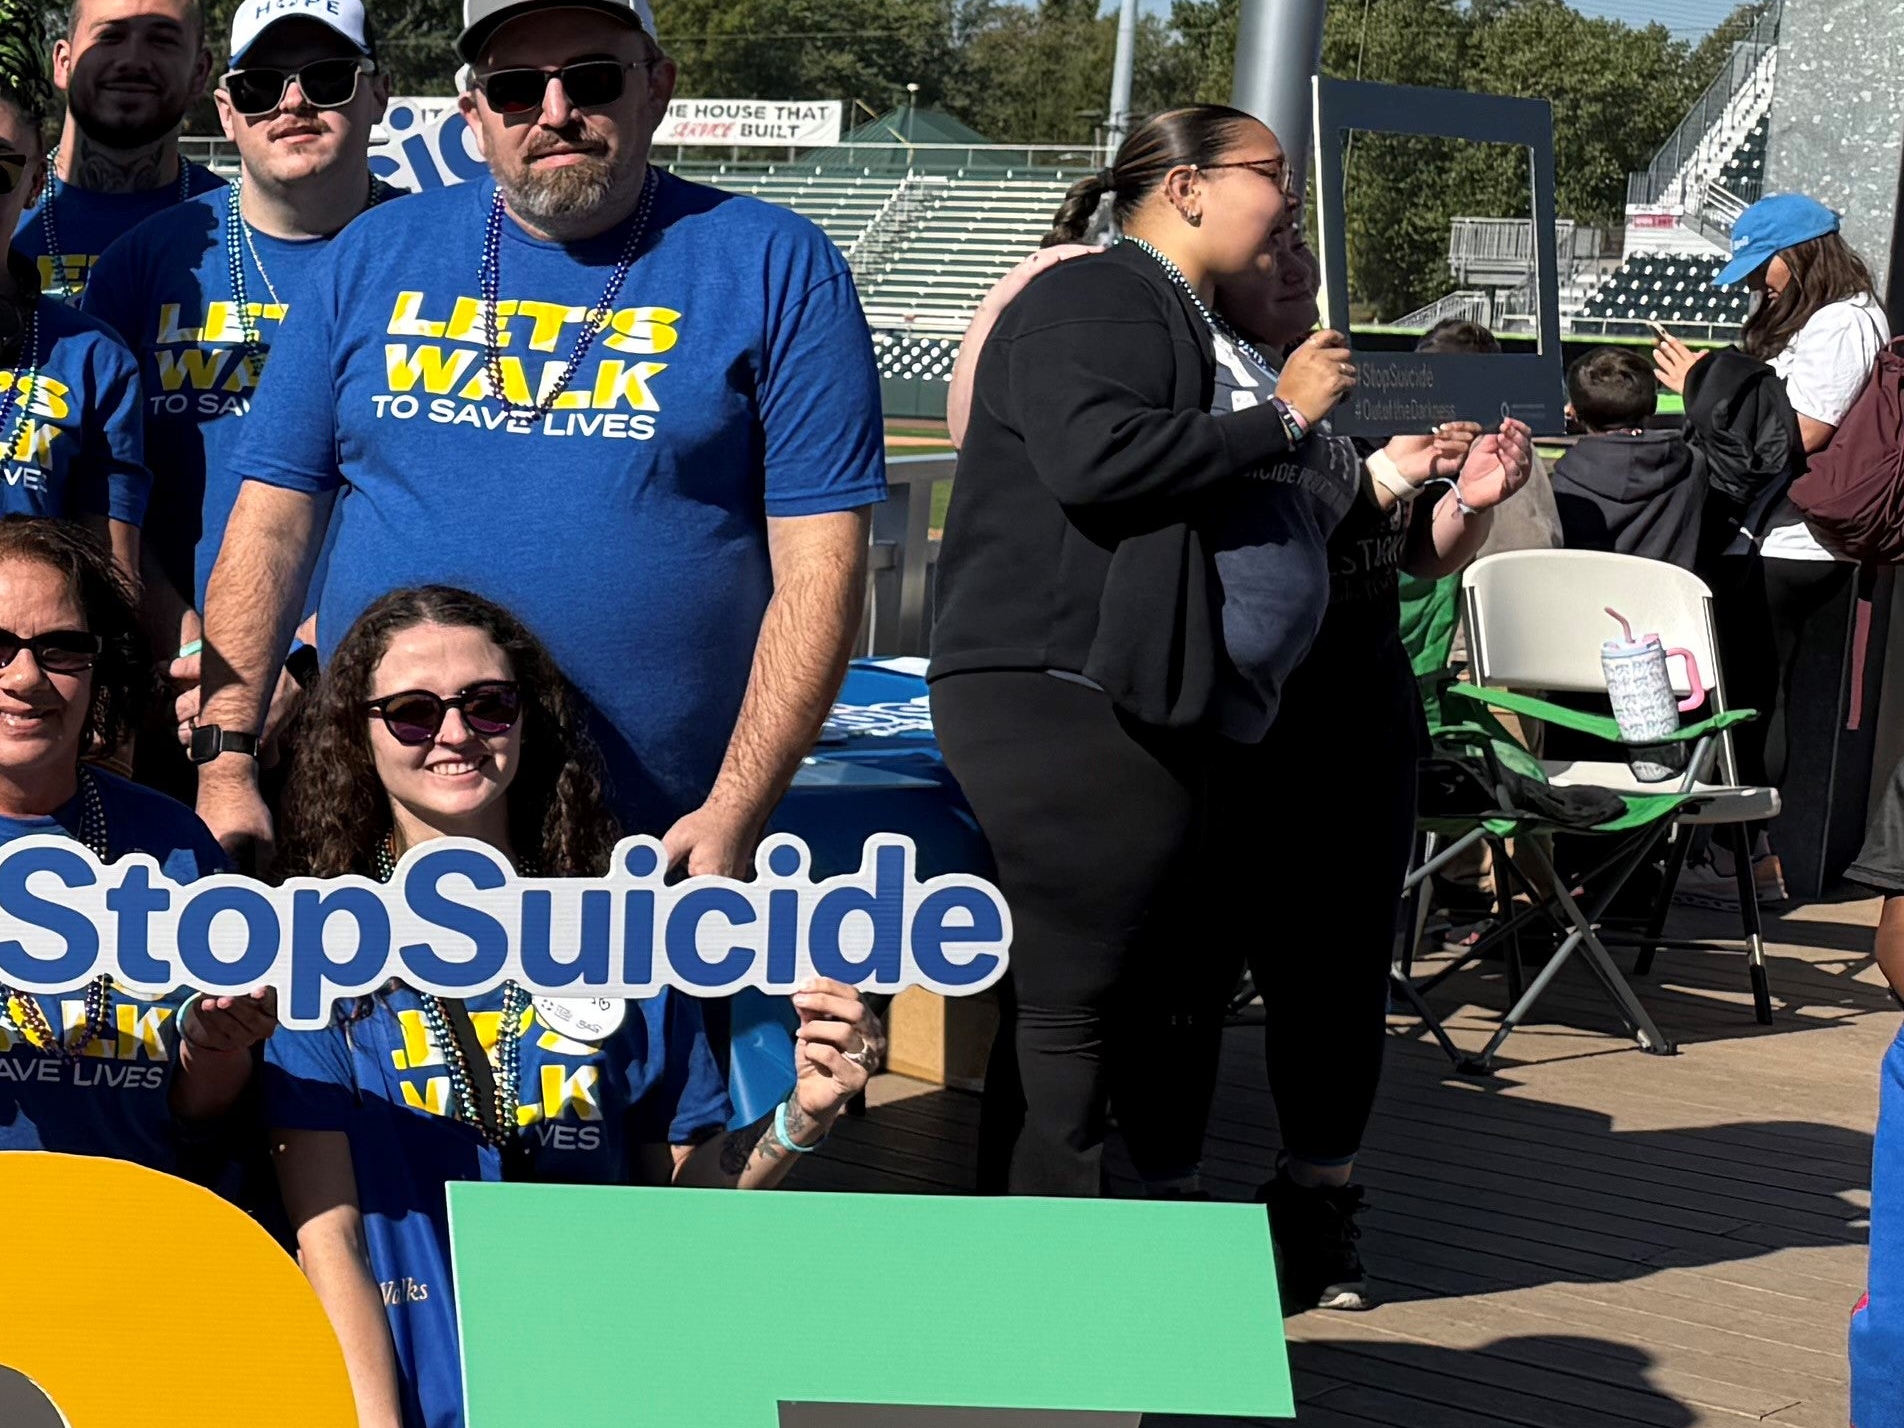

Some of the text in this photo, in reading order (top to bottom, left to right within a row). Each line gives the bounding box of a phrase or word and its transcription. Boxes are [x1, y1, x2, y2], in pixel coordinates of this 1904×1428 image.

[694, 105, 766, 121] HOUSE
[775, 106, 829, 122] THAT
[740, 124, 800, 139] BUILT
[158, 302, 289, 347] LET
[387, 291, 682, 355] LET'S
[156, 350, 265, 392] WA
[386, 344, 668, 412] WALK
[149, 396, 186, 416] TO
[371, 395, 656, 441] TO SAVE LIVES
[73, 1063, 163, 1089] LIVES
[538, 1125, 601, 1151] VES
